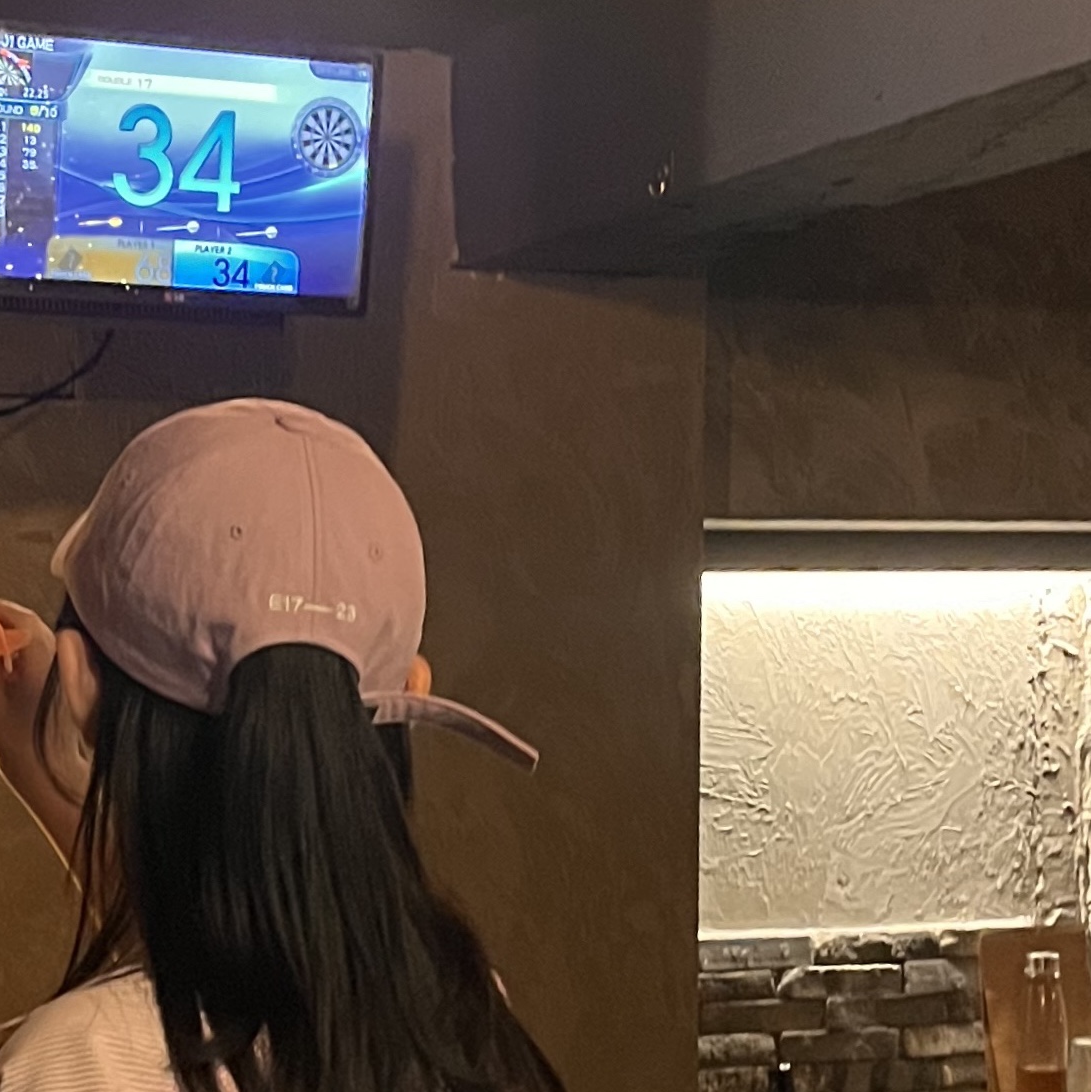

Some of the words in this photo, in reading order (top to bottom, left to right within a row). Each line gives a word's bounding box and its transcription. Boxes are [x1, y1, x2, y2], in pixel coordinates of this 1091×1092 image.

[17, 35, 55, 51] GAME
[138, 78, 153, 89] 17
[112, 103, 241, 214] 34
[212, 258, 250, 289] 34
